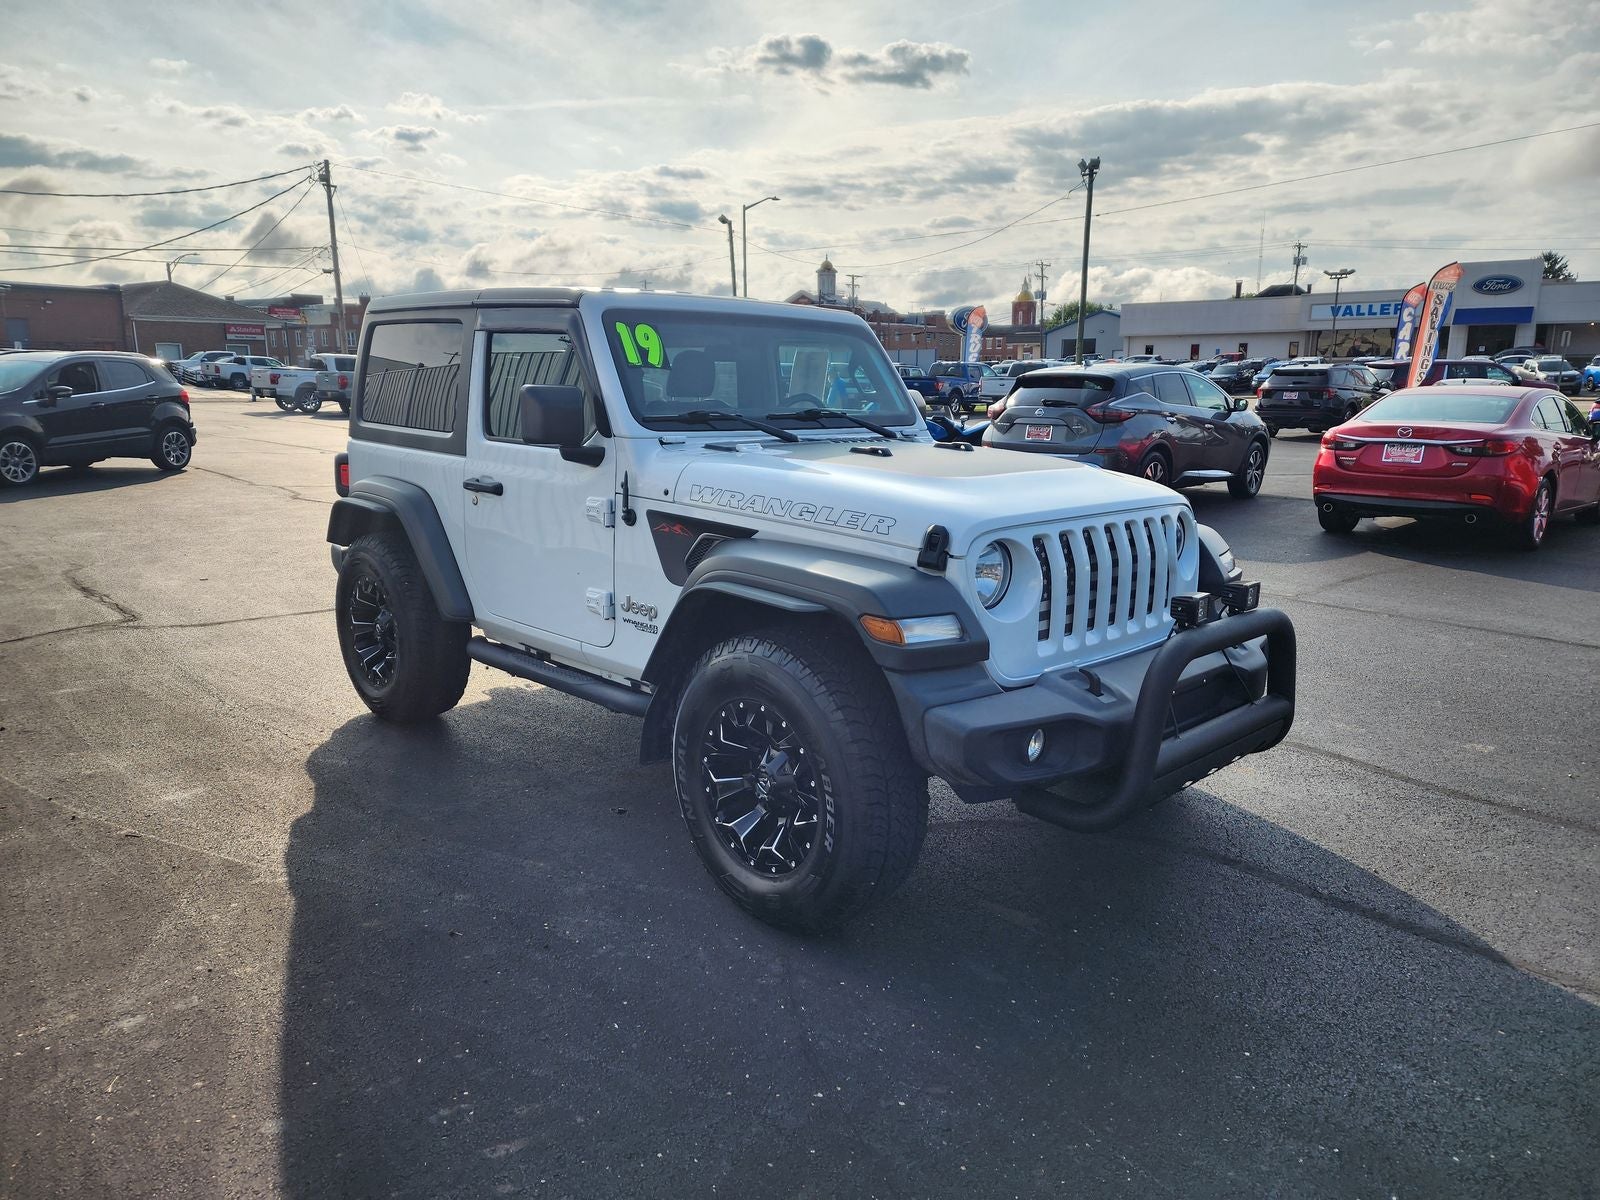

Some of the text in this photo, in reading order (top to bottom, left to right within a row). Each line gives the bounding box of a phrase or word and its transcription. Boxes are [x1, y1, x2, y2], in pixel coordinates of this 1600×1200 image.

[1482, 279, 1512, 290] Ford
[615, 321, 664, 368] 19
[1416, 293, 1444, 383] SAVINGS
[689, 484, 897, 536] WRANGLER
[620, 594, 658, 622] Jeep
[622, 616, 659, 630] WRANGLER
